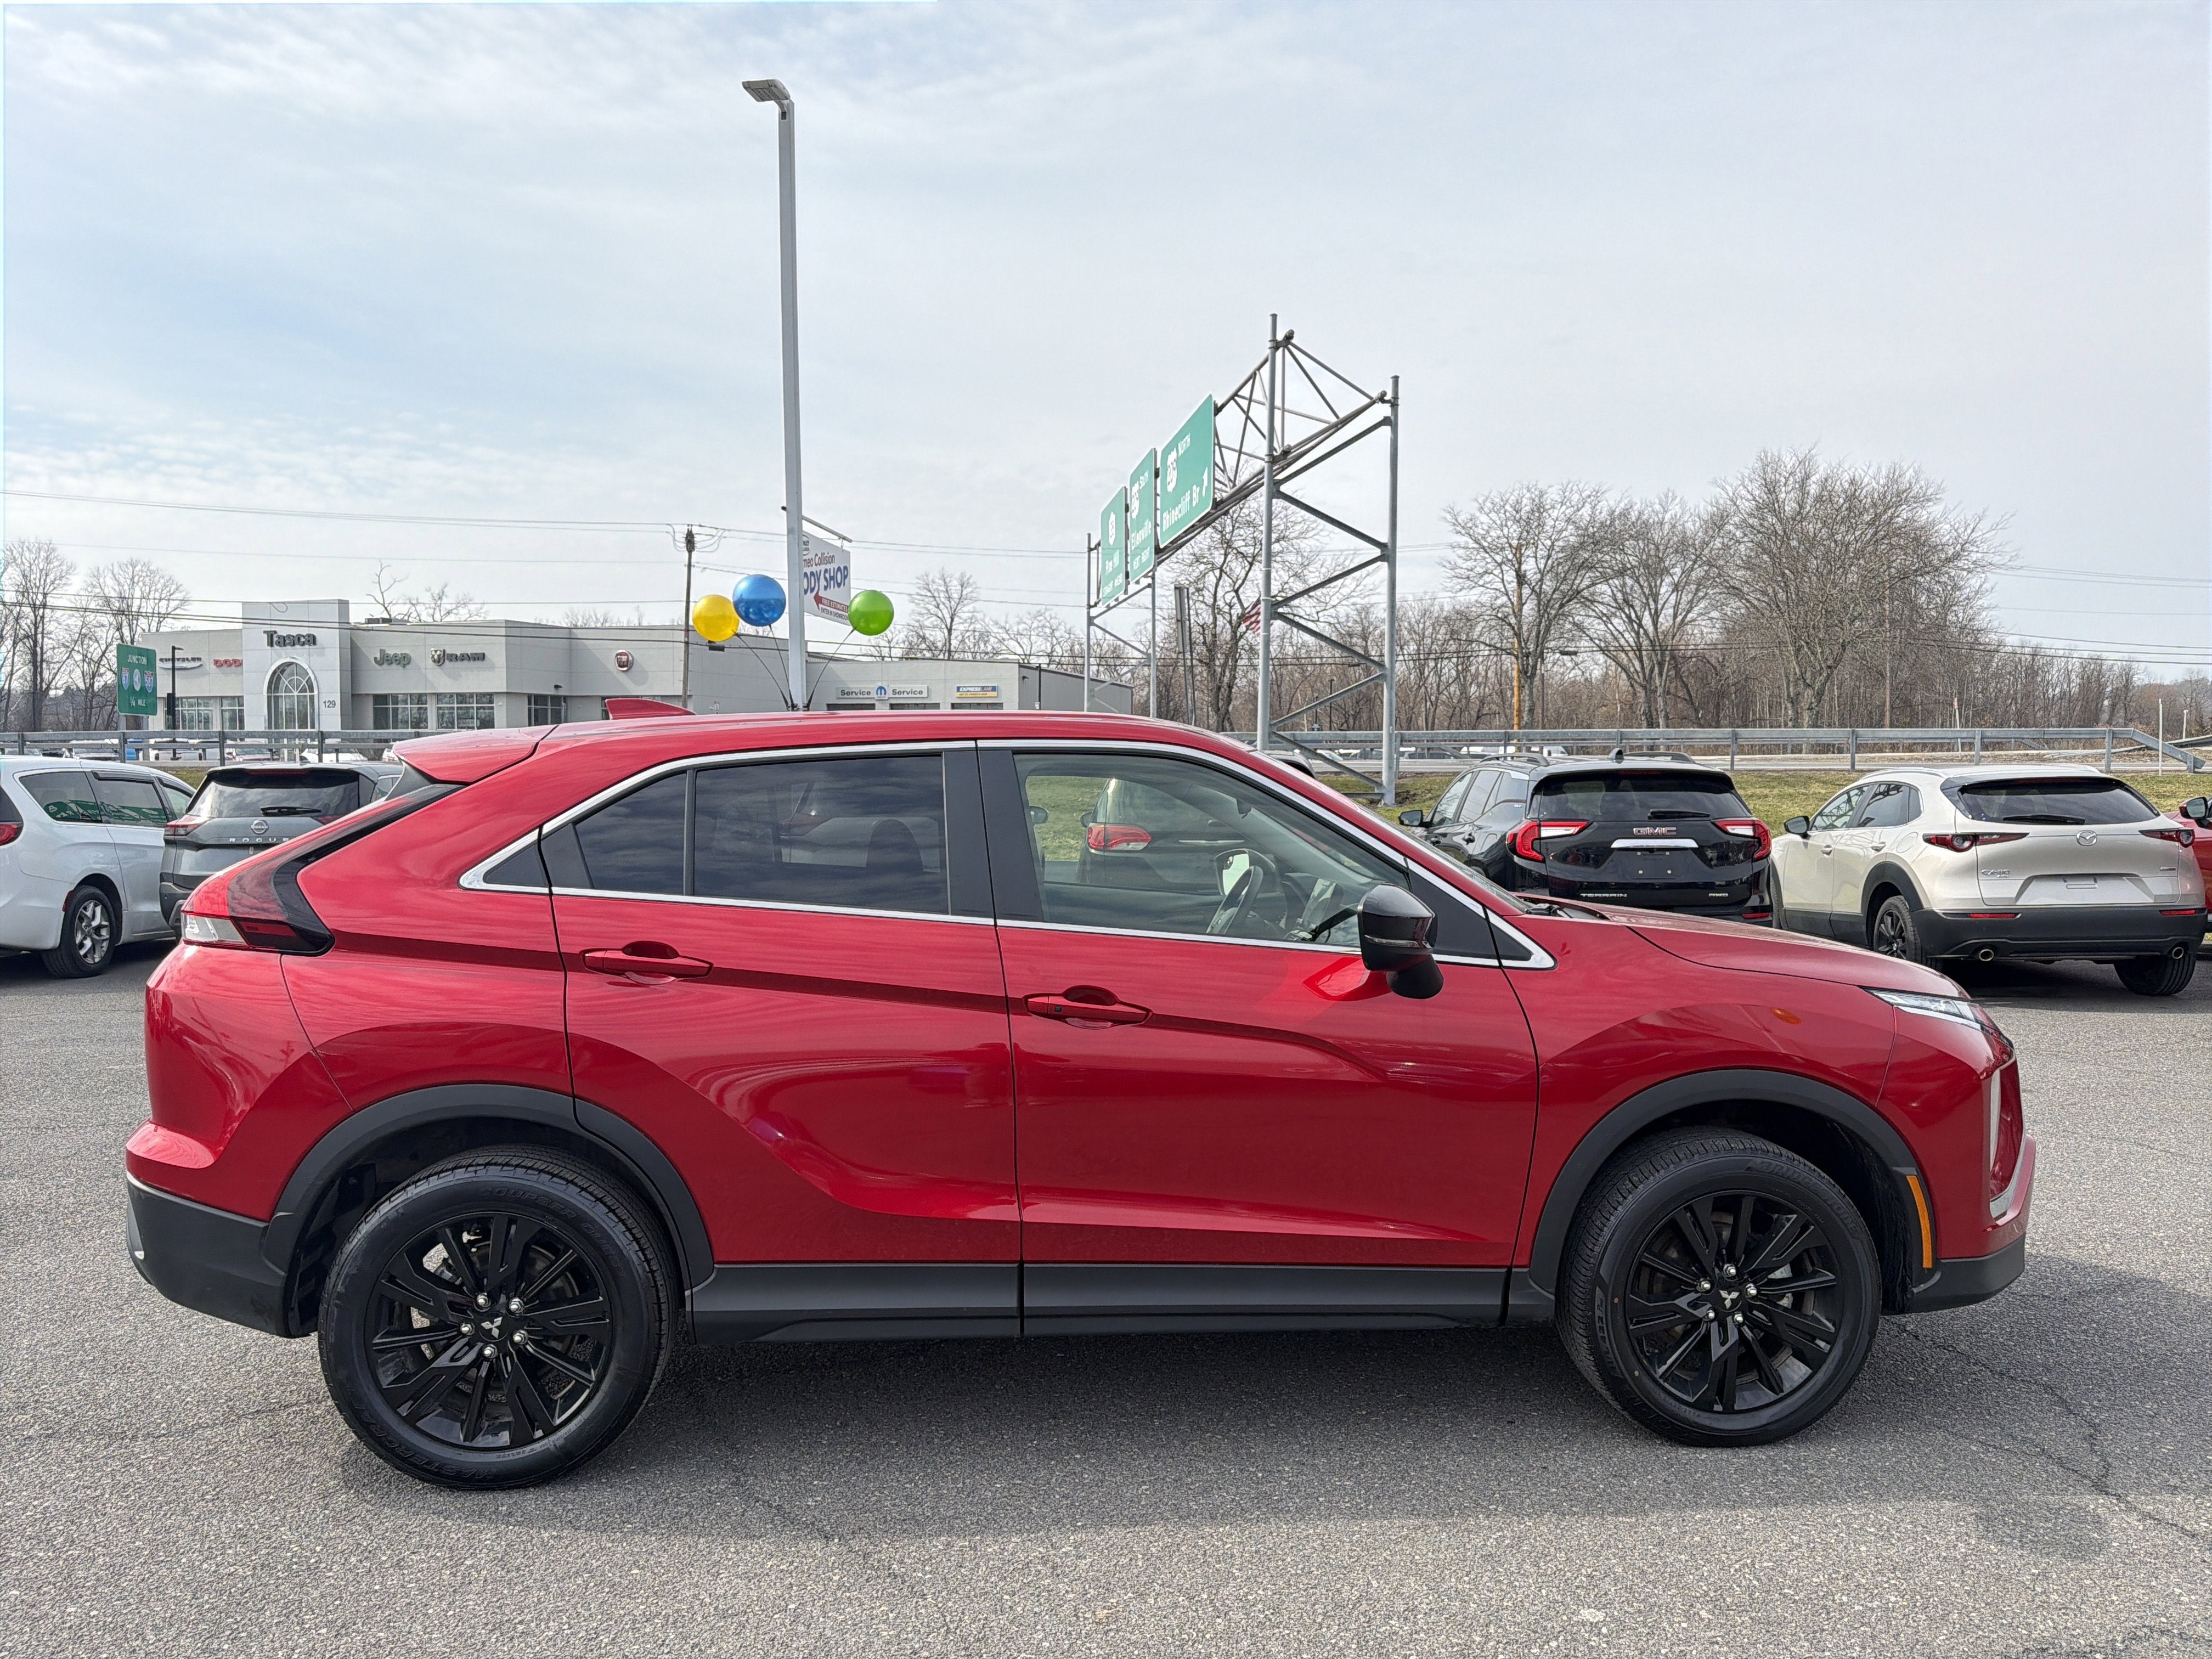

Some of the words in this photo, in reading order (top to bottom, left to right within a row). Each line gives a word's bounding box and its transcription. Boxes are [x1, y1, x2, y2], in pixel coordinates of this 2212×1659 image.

[1163, 490, 1190, 532] Rhinecliff
[1192, 484, 1200, 507] Br
[803, 556, 814, 568] meo
[814, 551, 836, 567] Collision
[803, 569, 822, 595] ODY
[823, 565, 849, 591] SHOP
[822, 597, 830, 607] FREE
[830, 601, 848, 612] ESTIMATES
[833, 611, 849, 621] SHOWROO
[263, 630, 317, 647] Tasca
[127, 654, 147, 665] JUNCTION
[374, 648, 411, 668] Jeep
[446, 652, 486, 662] RAM
[213, 658, 244, 668] DOD
[137, 698, 146, 707] MILE
[323, 700, 336, 709] 129
[1633, 827, 1677, 836] GMC
